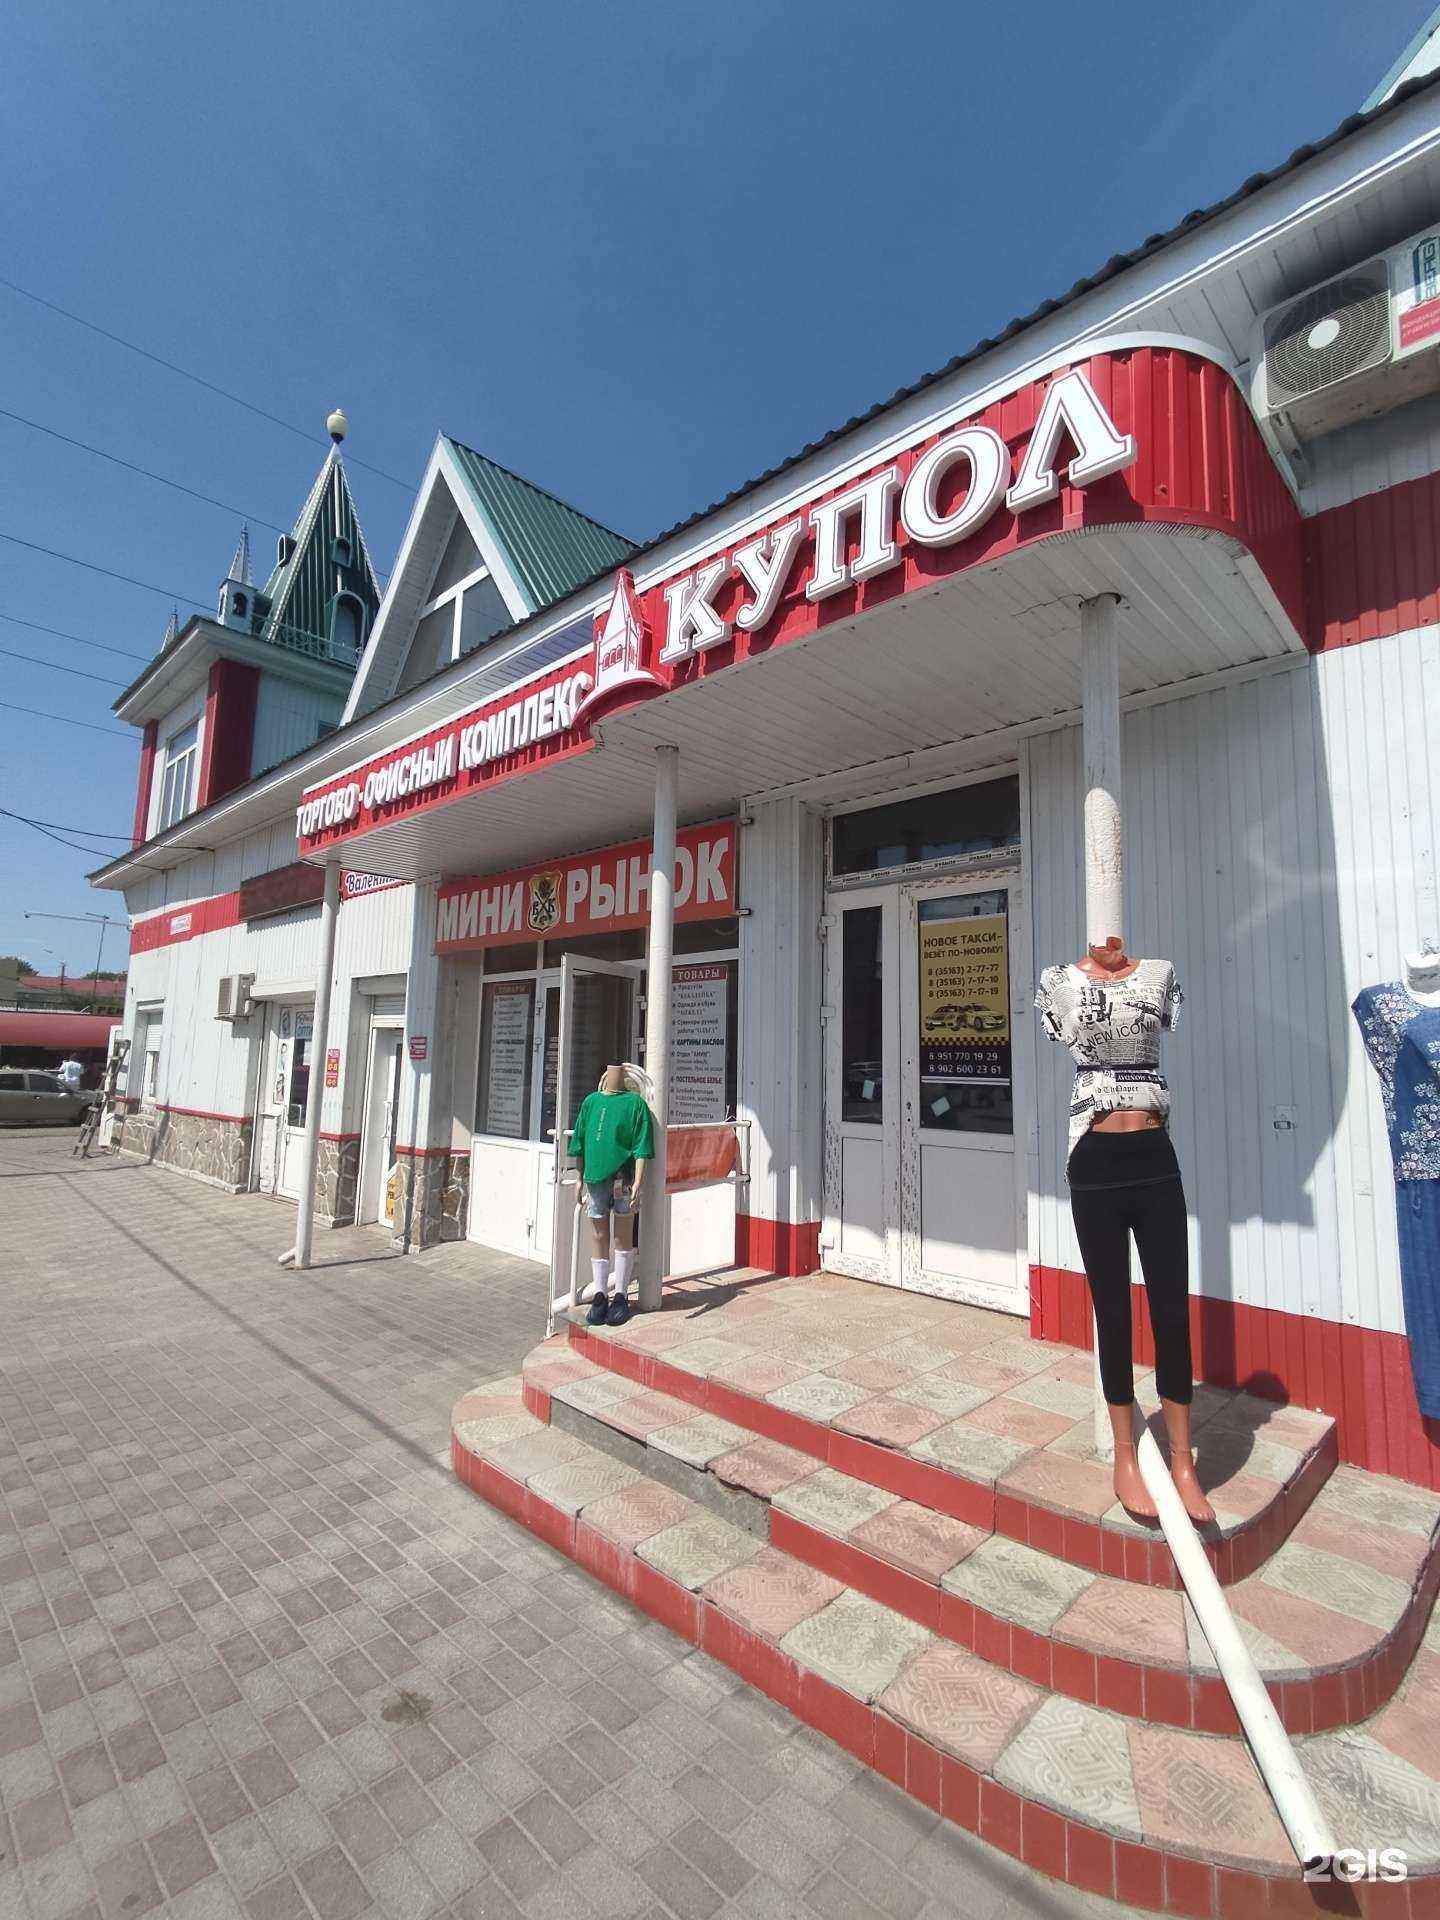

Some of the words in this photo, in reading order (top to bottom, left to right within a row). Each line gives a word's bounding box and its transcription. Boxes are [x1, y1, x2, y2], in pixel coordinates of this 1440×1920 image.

[659, 368, 1137, 665] КУПОЛ
[457, 671, 594, 770] КОМПЛЕКС
[437, 880, 524, 942] МИНИ
[565, 837, 729, 923] РЫНОК
[923, 936, 958, 948] НОВОЕ
[967, 963, 999, 974] 2-77-77
[1086, 1028, 1113, 1050] NEW
[937, 1052, 952, 1061] 951
[954, 1052, 970, 1060] 770
[973, 1052, 983, 1060] 19
[986, 1052, 998, 1061] 29
[937, 1064, 953, 1073] 902
[956, 1065, 973, 1073] 600
[976, 1065, 988, 1074] 23
[990, 1065, 1001, 1074] 61
